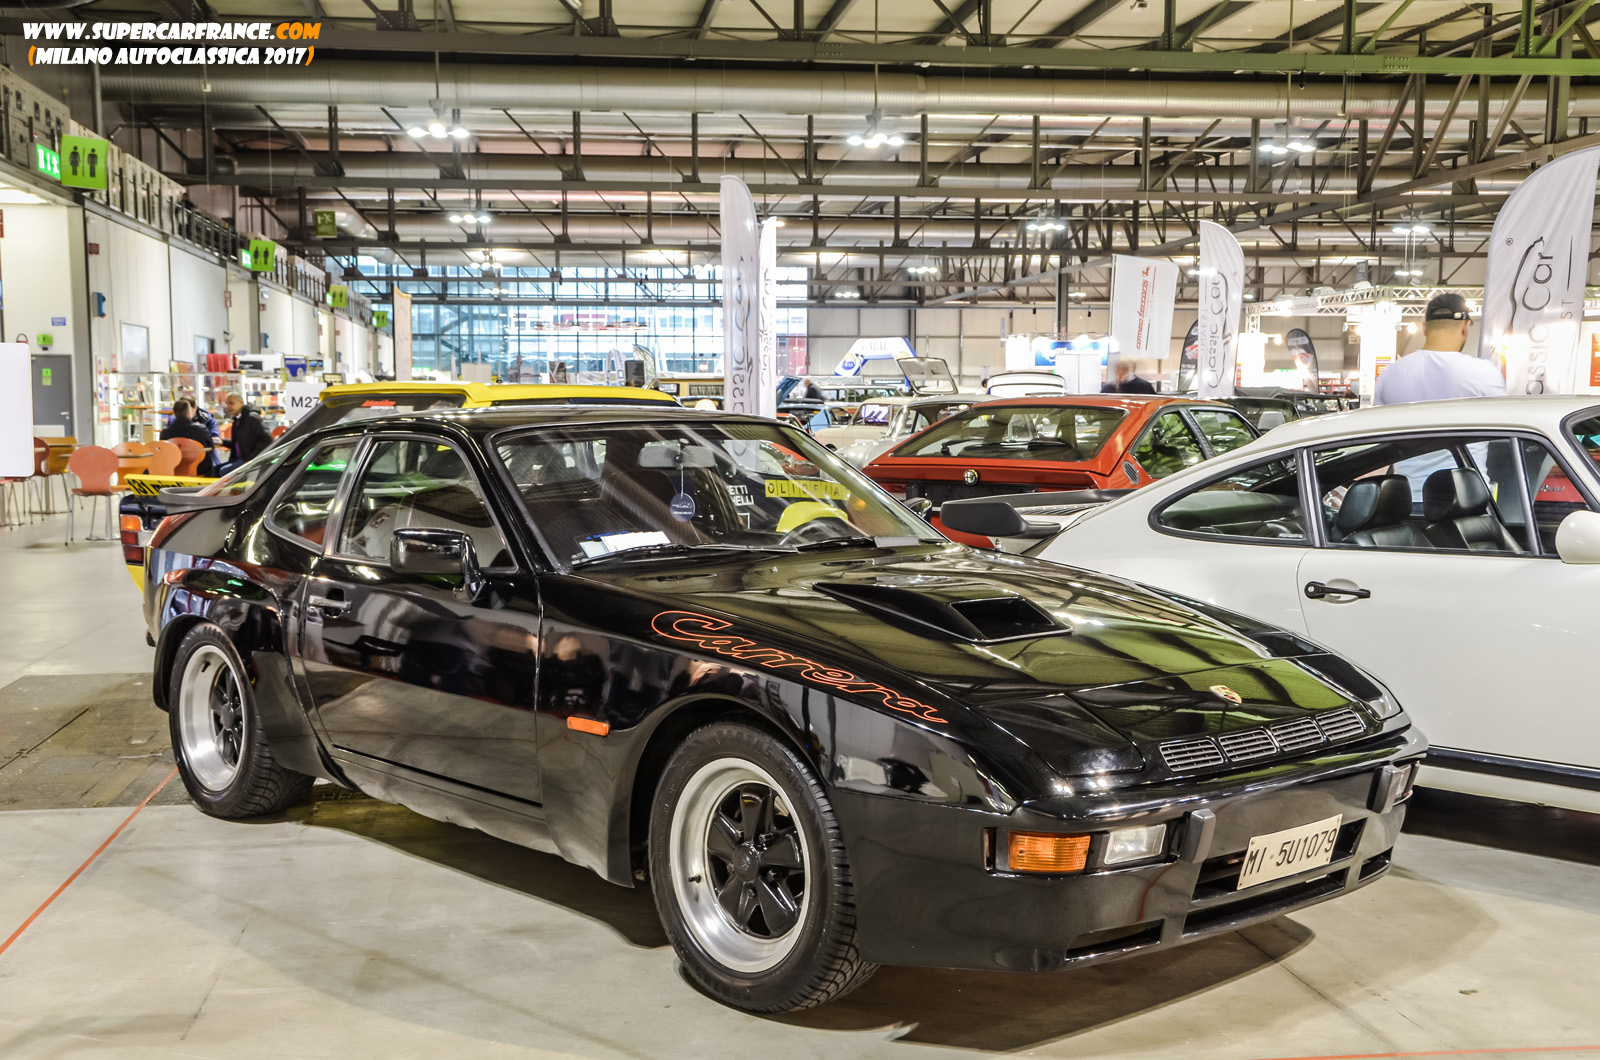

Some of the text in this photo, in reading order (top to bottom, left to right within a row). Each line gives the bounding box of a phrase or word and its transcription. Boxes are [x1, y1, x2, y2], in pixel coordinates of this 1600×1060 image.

[126, 478, 155, 495] 131
[726, 485, 748, 495] ETTI
[767, 482, 840, 496] OLIOFIA
[651, 610, 949, 724] Carrera
[1243, 827, 1337, 877] MI 5U1079
